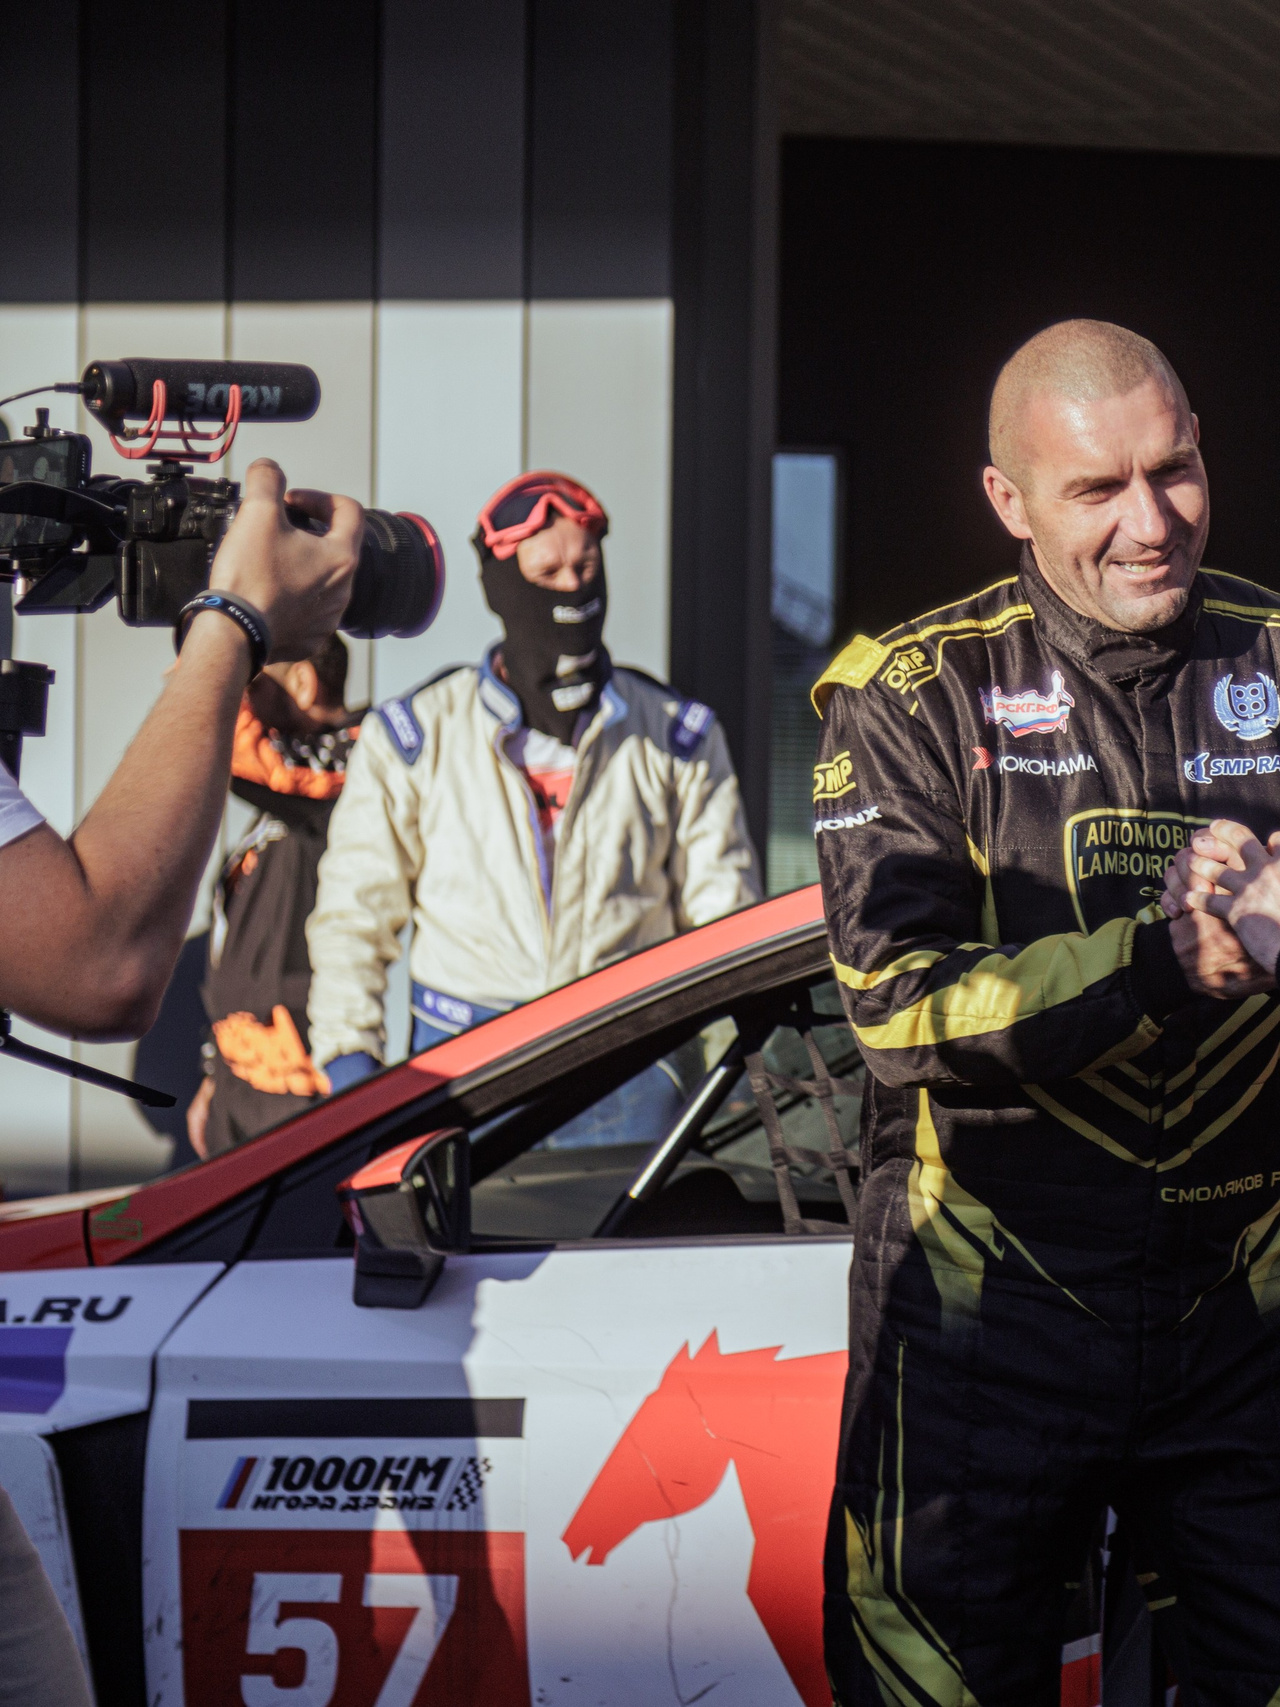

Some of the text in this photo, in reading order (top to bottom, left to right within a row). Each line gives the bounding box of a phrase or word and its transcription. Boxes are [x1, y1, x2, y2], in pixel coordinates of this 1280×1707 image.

[884, 650, 928, 690] OMP
[995, 701, 1058, 714] РСКГ.РФ
[996, 753, 1100, 777] YOKOHAMA
[1210, 757, 1255, 776] SMP
[1160, 1173, 1264, 1203] СМОЛЯКОВ
[0, 1296, 132, 1323] .RU
[240, 1572, 460, 1707] 57
